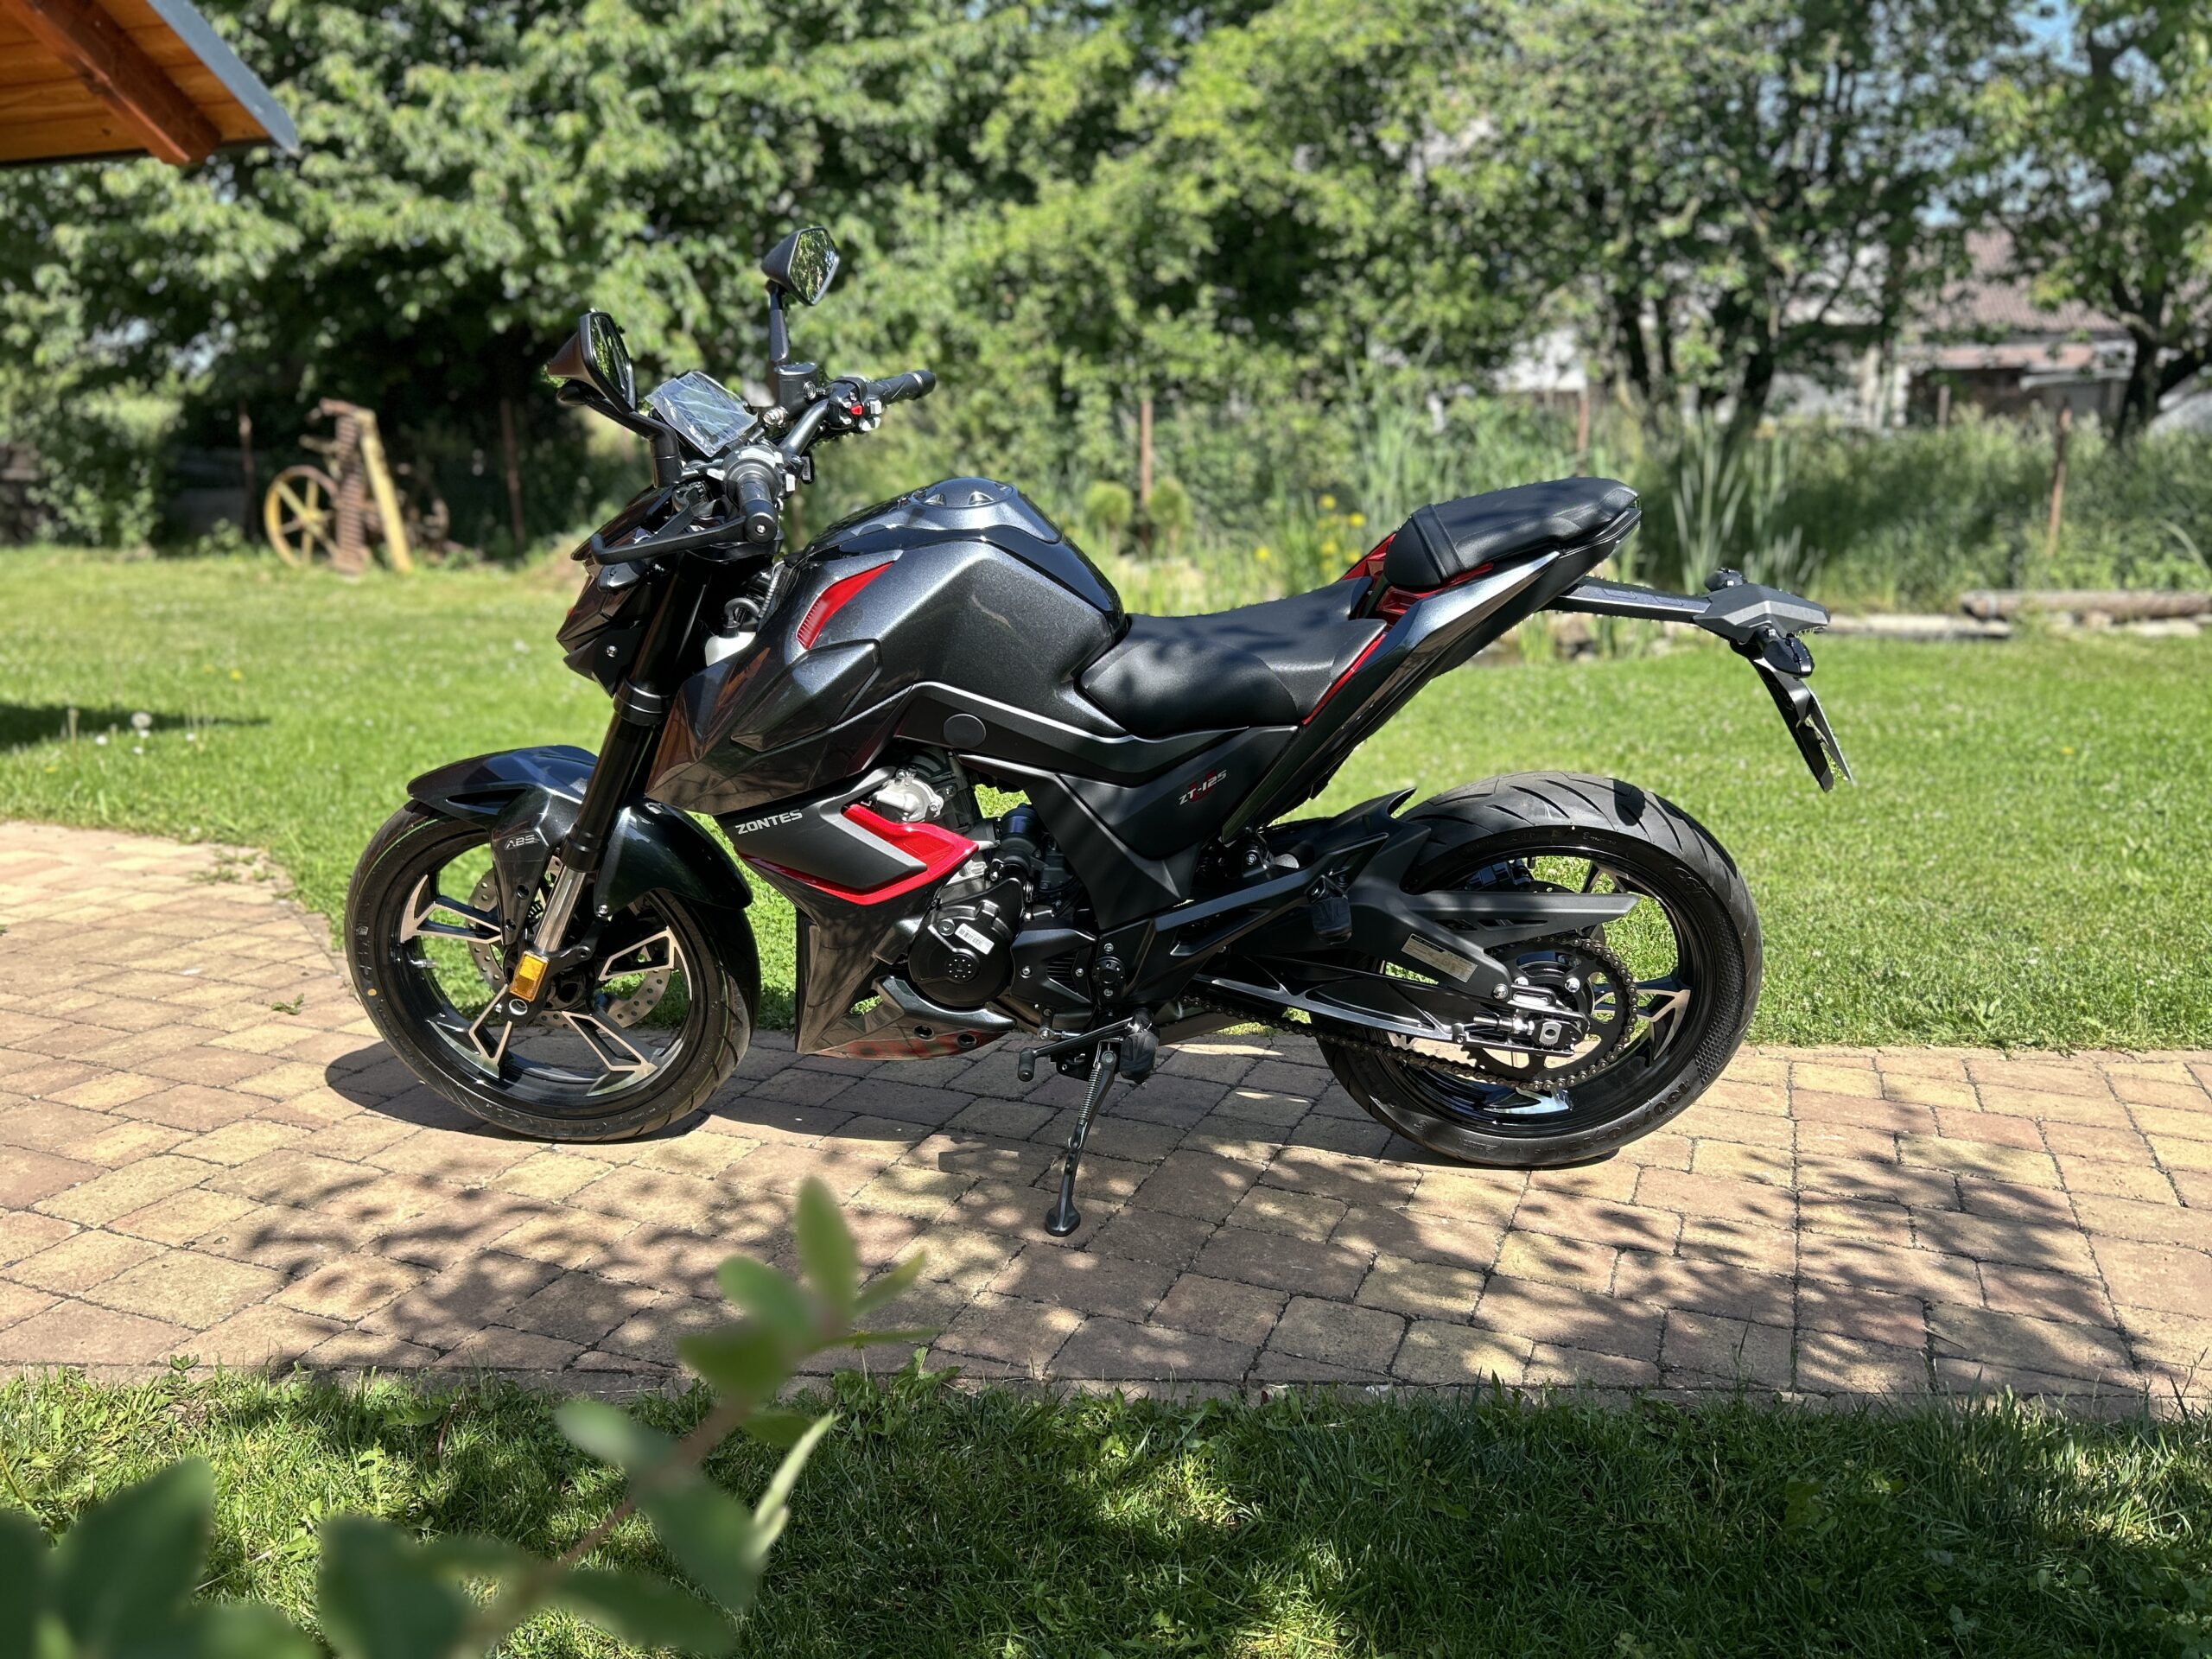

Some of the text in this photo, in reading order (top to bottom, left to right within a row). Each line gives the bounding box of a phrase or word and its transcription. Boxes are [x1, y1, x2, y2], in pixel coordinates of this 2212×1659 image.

[1179, 769, 1227, 805] ZT-125
[734, 809, 803, 835] ZONTES
[505, 834, 537, 849] ABS
